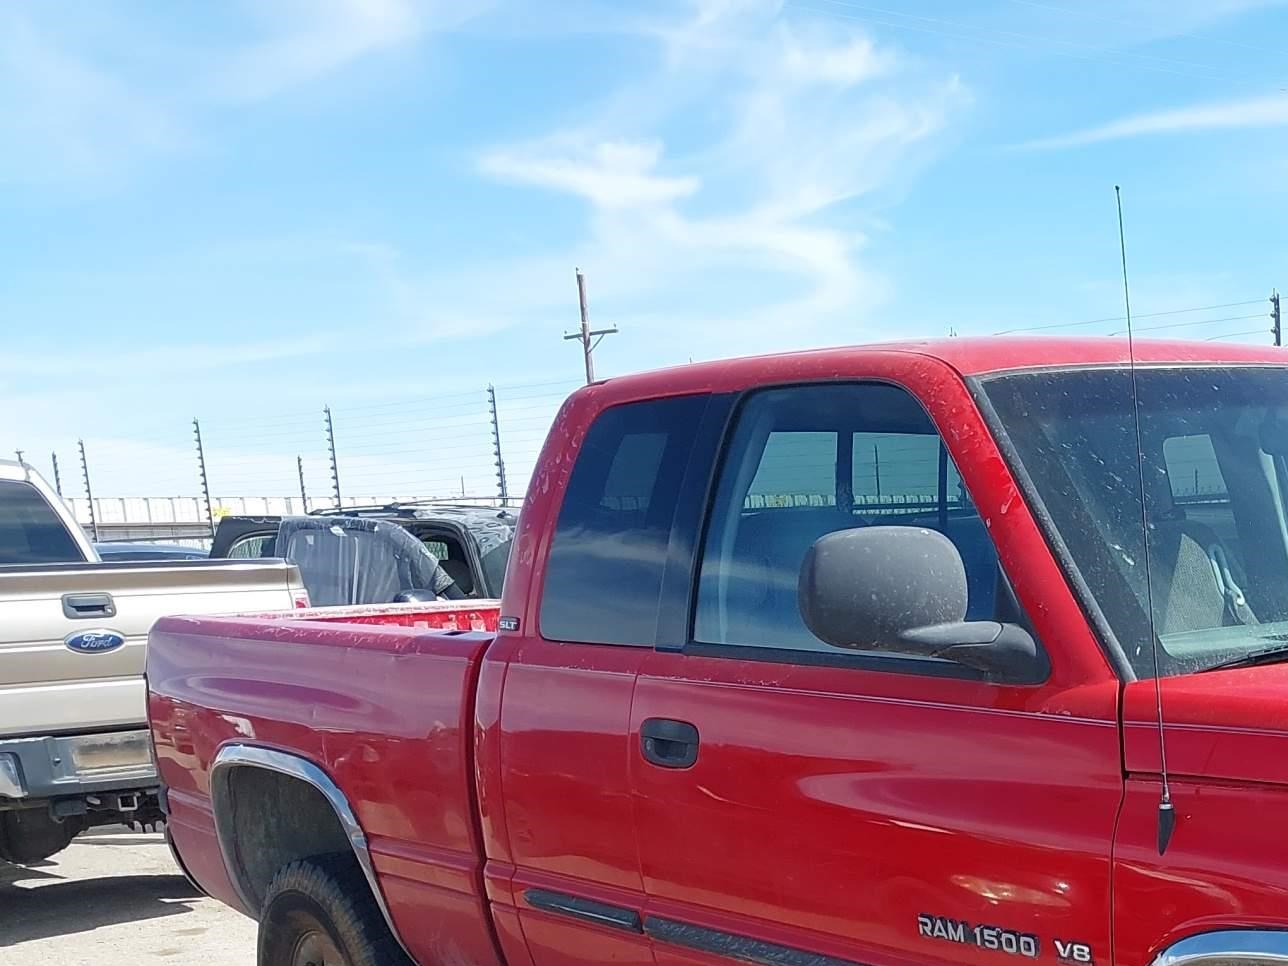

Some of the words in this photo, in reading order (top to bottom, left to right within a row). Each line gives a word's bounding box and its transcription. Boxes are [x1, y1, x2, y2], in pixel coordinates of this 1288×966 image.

[499, 620, 518, 630] SLT
[80, 633, 113, 648] Ford
[918, 914, 965, 943] RAM
[974, 923, 1036, 958] 1500
[1054, 939, 1091, 962] V8
